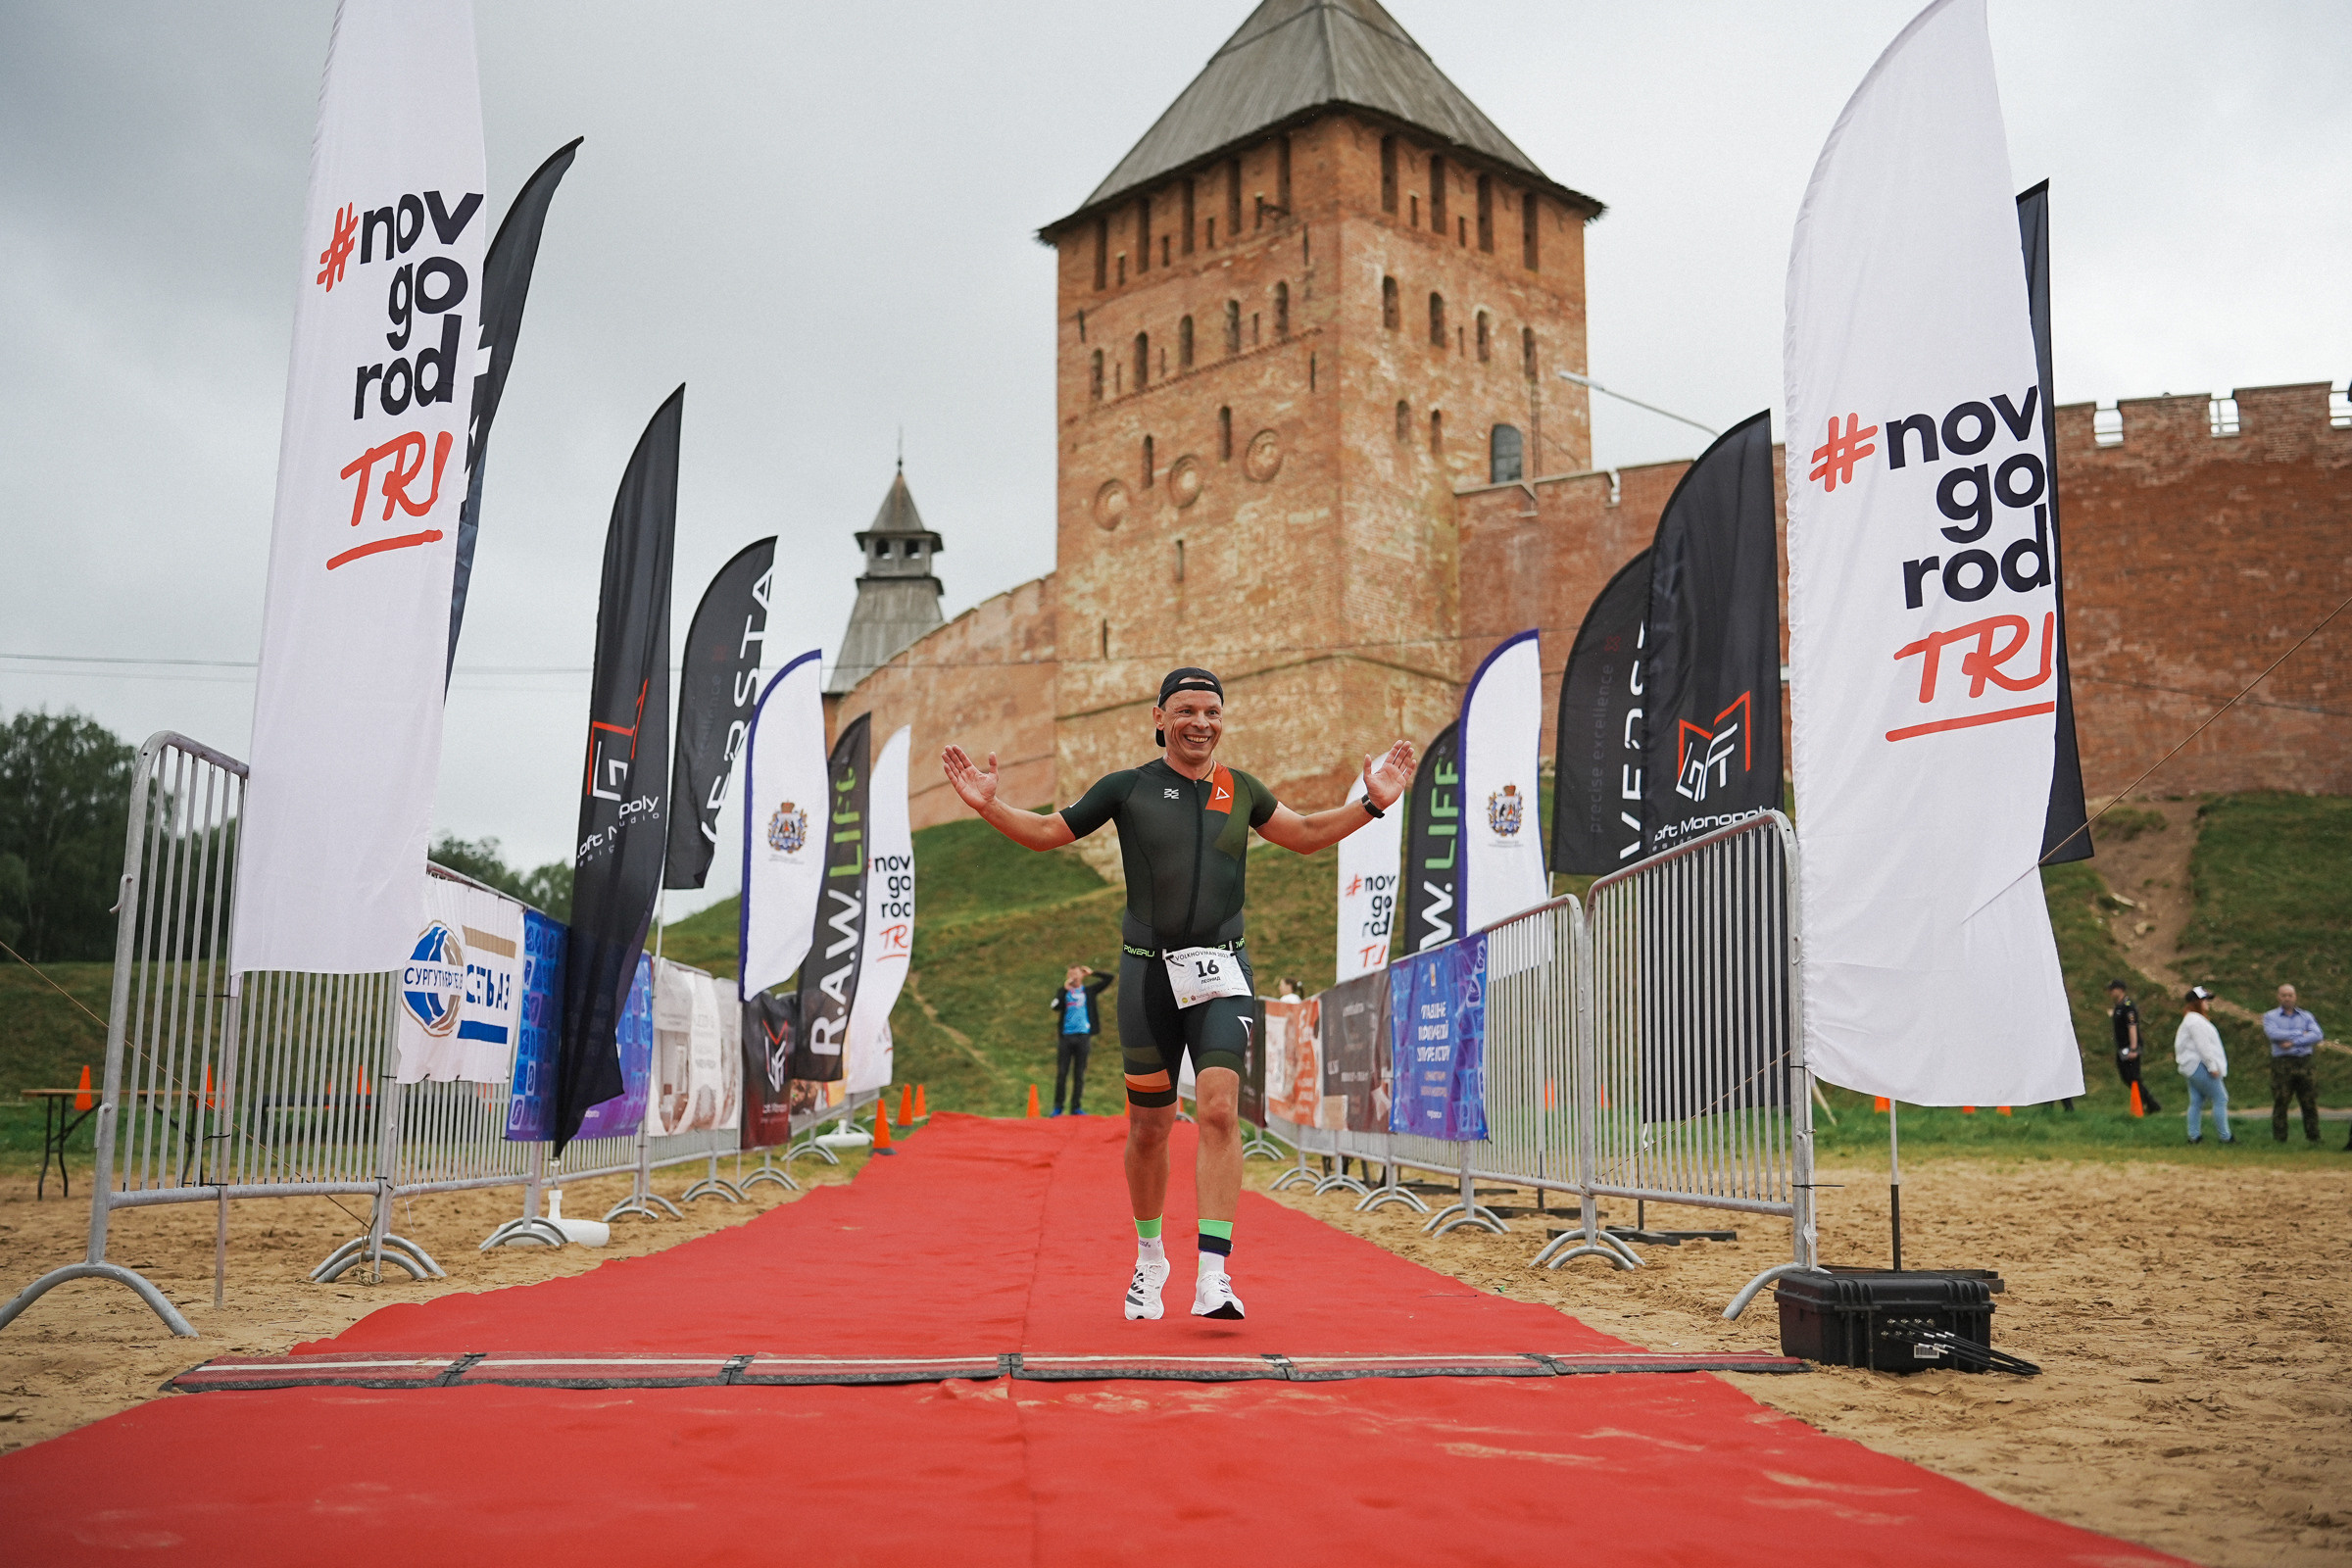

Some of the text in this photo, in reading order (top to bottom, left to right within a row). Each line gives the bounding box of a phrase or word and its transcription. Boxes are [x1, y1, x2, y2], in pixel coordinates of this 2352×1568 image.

[317, 190, 484, 292] #nov
[386, 256, 468, 351] go
[354, 314, 462, 419] rod
[1809, 385, 2038, 492] #nov
[340, 431, 453, 526] TRI
[1936, 453, 2046, 544] go
[1902, 504, 2052, 610] rod
[1893, 612, 2054, 704] TRI
[1588, 664, 1614, 833] precise excellence
[577, 833, 604, 859] oft
[618, 811, 660, 827] udio
[1653, 824, 1678, 843] oft
[1681, 805, 1776, 835] Monopol
[867, 854, 910, 873] nov
[888, 875, 910, 899] go
[1346, 874, 1396, 897] #nov
[1372, 896, 1392, 917] go
[809, 888, 862, 1056] R.A.W.
[1123, 944, 1155, 957] POWERU
[1175, 951, 1216, 961] VOLKHOVMAN
[1196, 959, 1219, 978] 16
